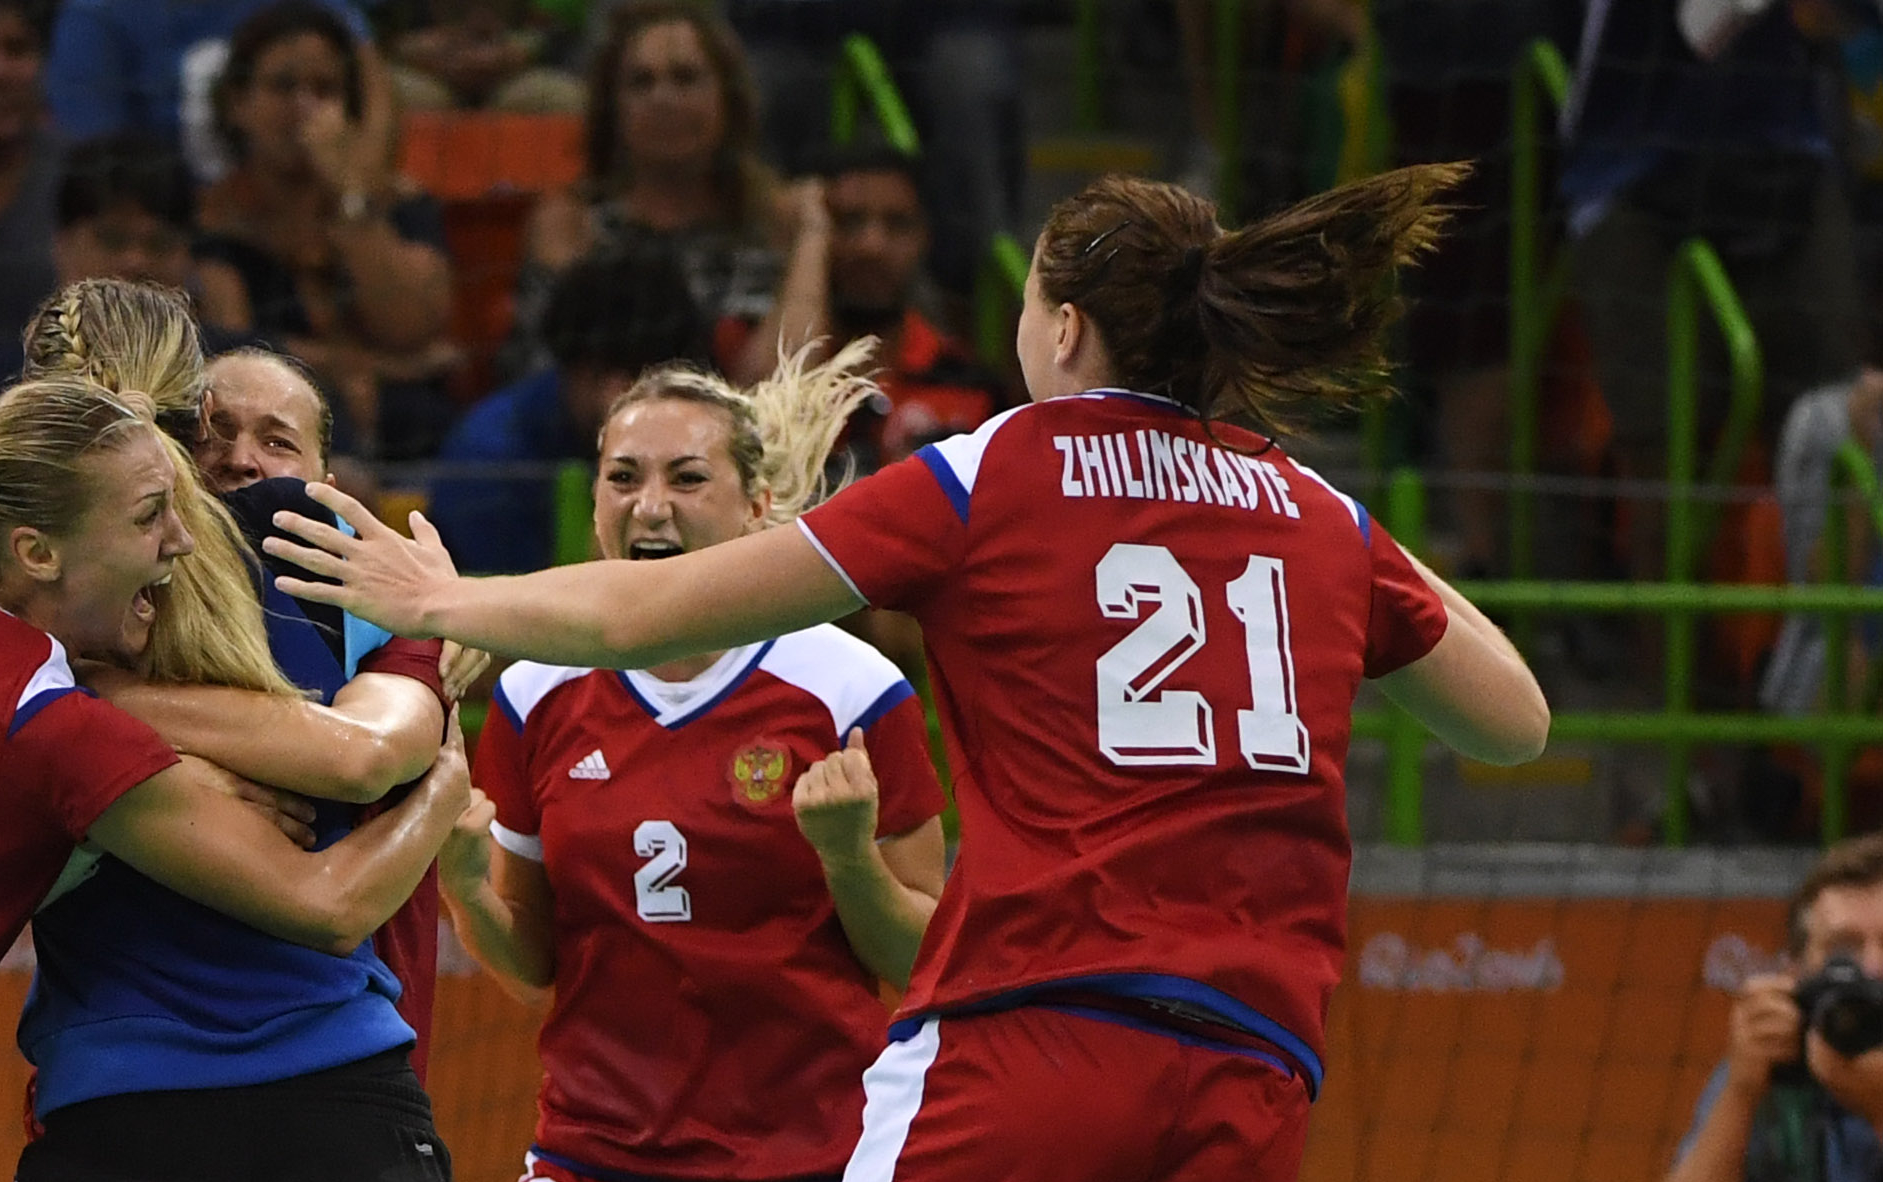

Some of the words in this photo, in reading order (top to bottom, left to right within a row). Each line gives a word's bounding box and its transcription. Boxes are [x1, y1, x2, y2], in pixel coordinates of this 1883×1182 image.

[1053, 429, 1301, 520] ZHILINSKAYTE
[1095, 543, 1310, 775] 21
[633, 820, 692, 922] 2
